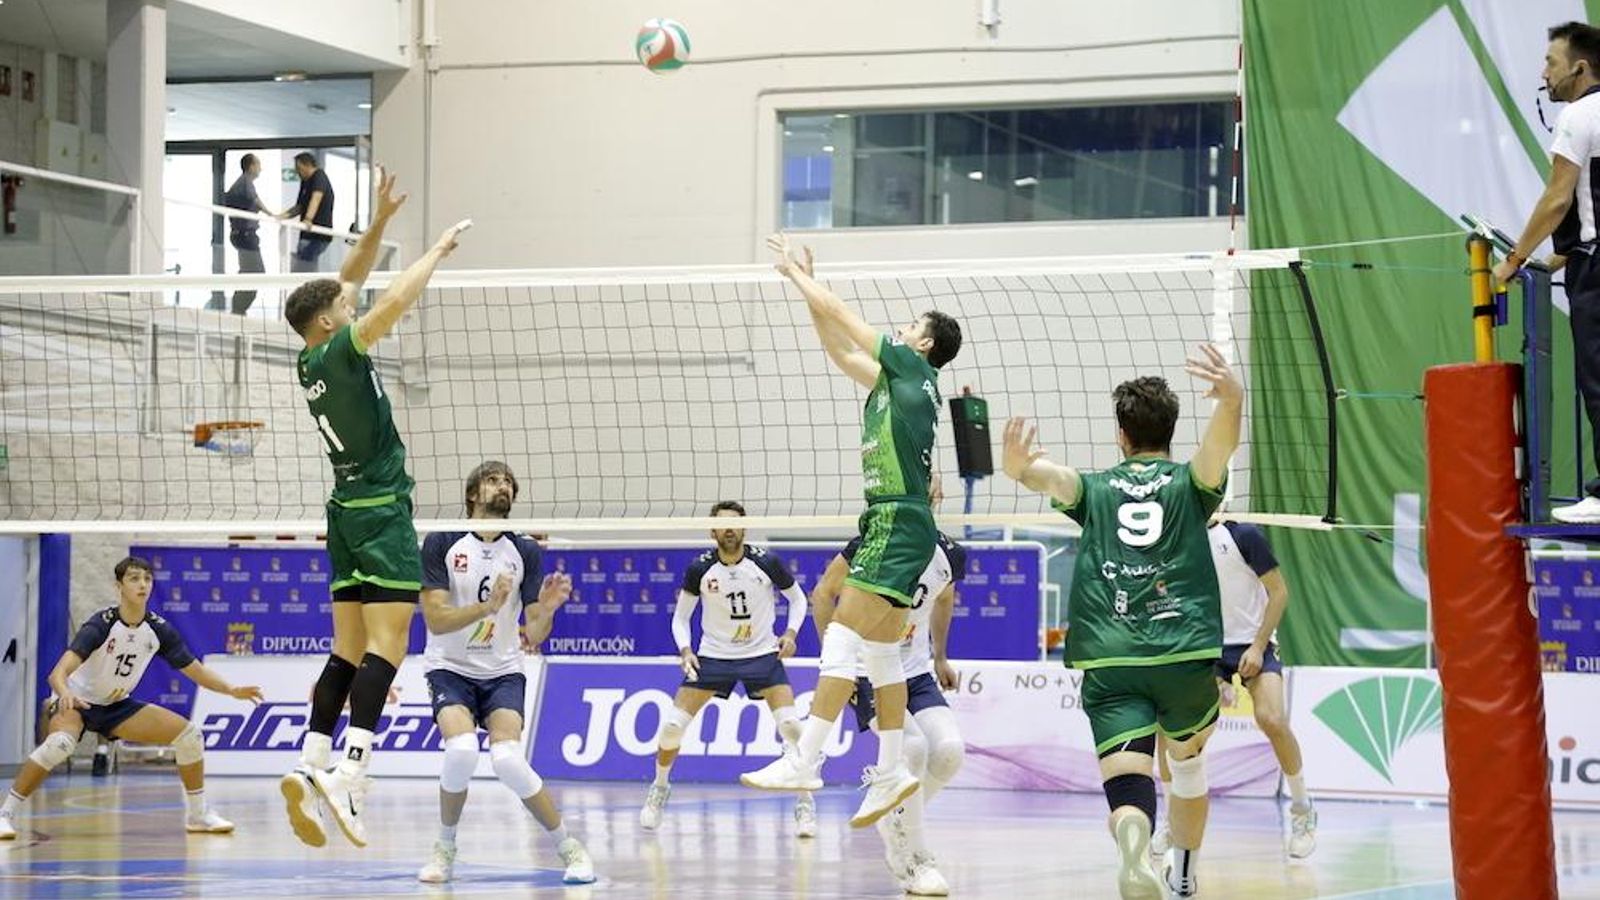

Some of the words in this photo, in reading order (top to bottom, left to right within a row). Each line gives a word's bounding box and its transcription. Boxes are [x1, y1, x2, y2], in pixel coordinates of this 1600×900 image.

[1117, 501, 1164, 547] 9
[726, 591, 749, 614] 11
[262, 637, 334, 651] DIPUTACI
[550, 635, 635, 653] DIPUTACIÓN
[115, 655, 137, 676] 15
[1014, 674, 1047, 690] NO
